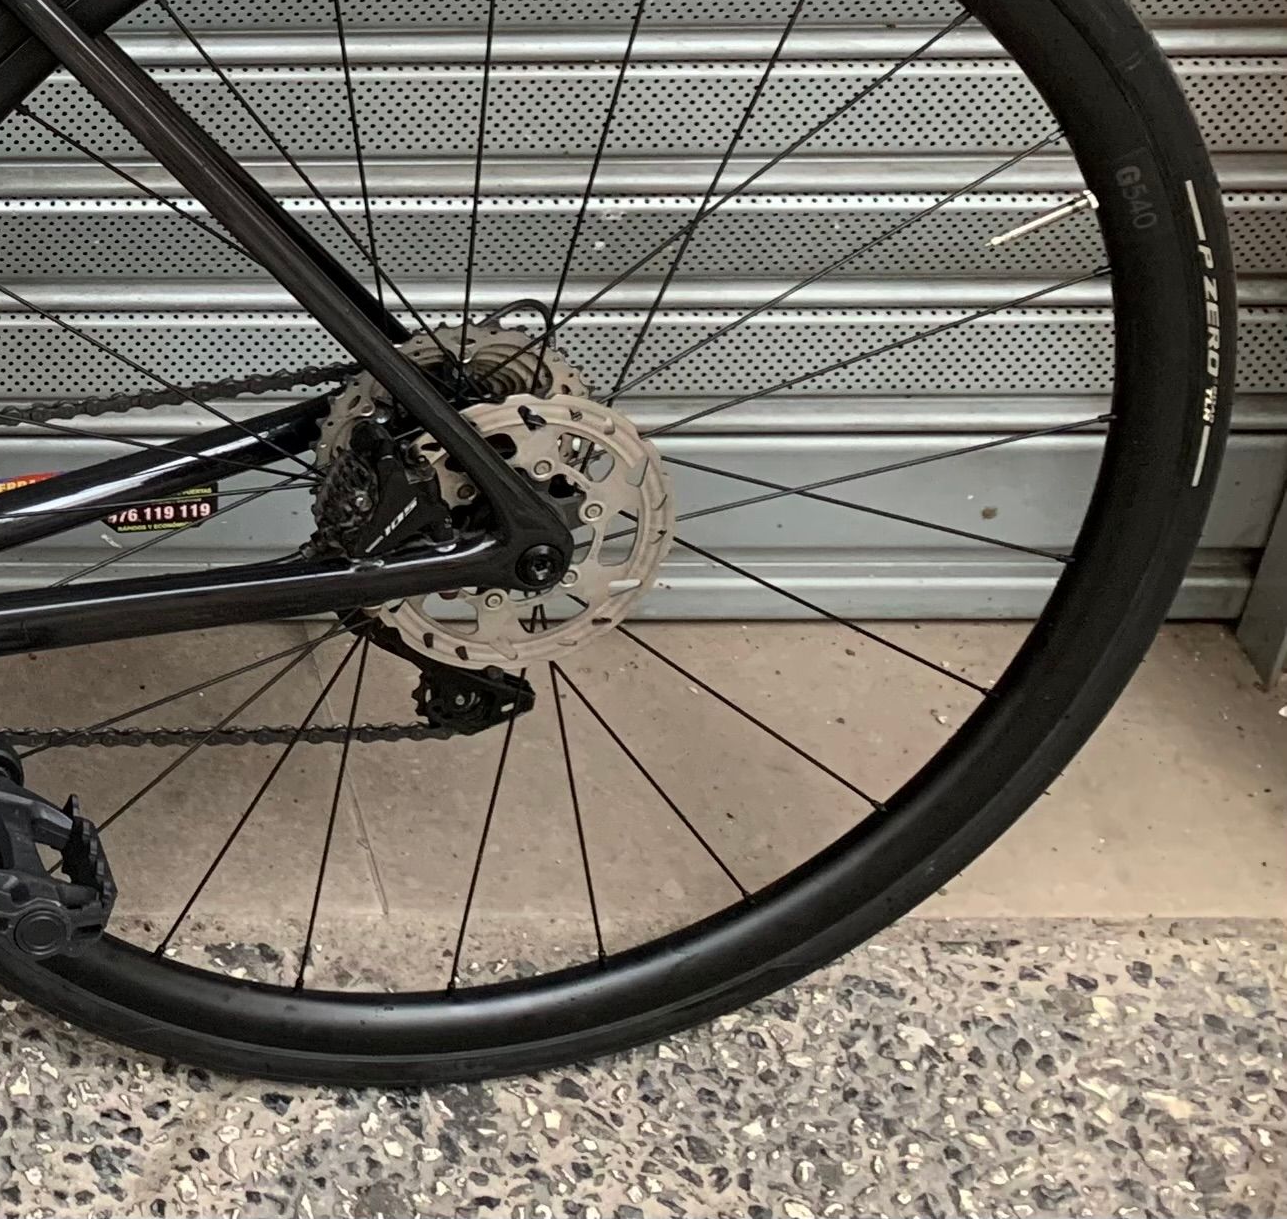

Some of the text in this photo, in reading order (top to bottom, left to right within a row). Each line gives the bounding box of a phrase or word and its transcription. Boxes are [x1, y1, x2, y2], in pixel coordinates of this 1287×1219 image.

[1197, 244, 1215, 270] P
[1203, 275, 1221, 378] ZERO
[143, 506, 175, 521] 119
[179, 503, 211, 518] 119
